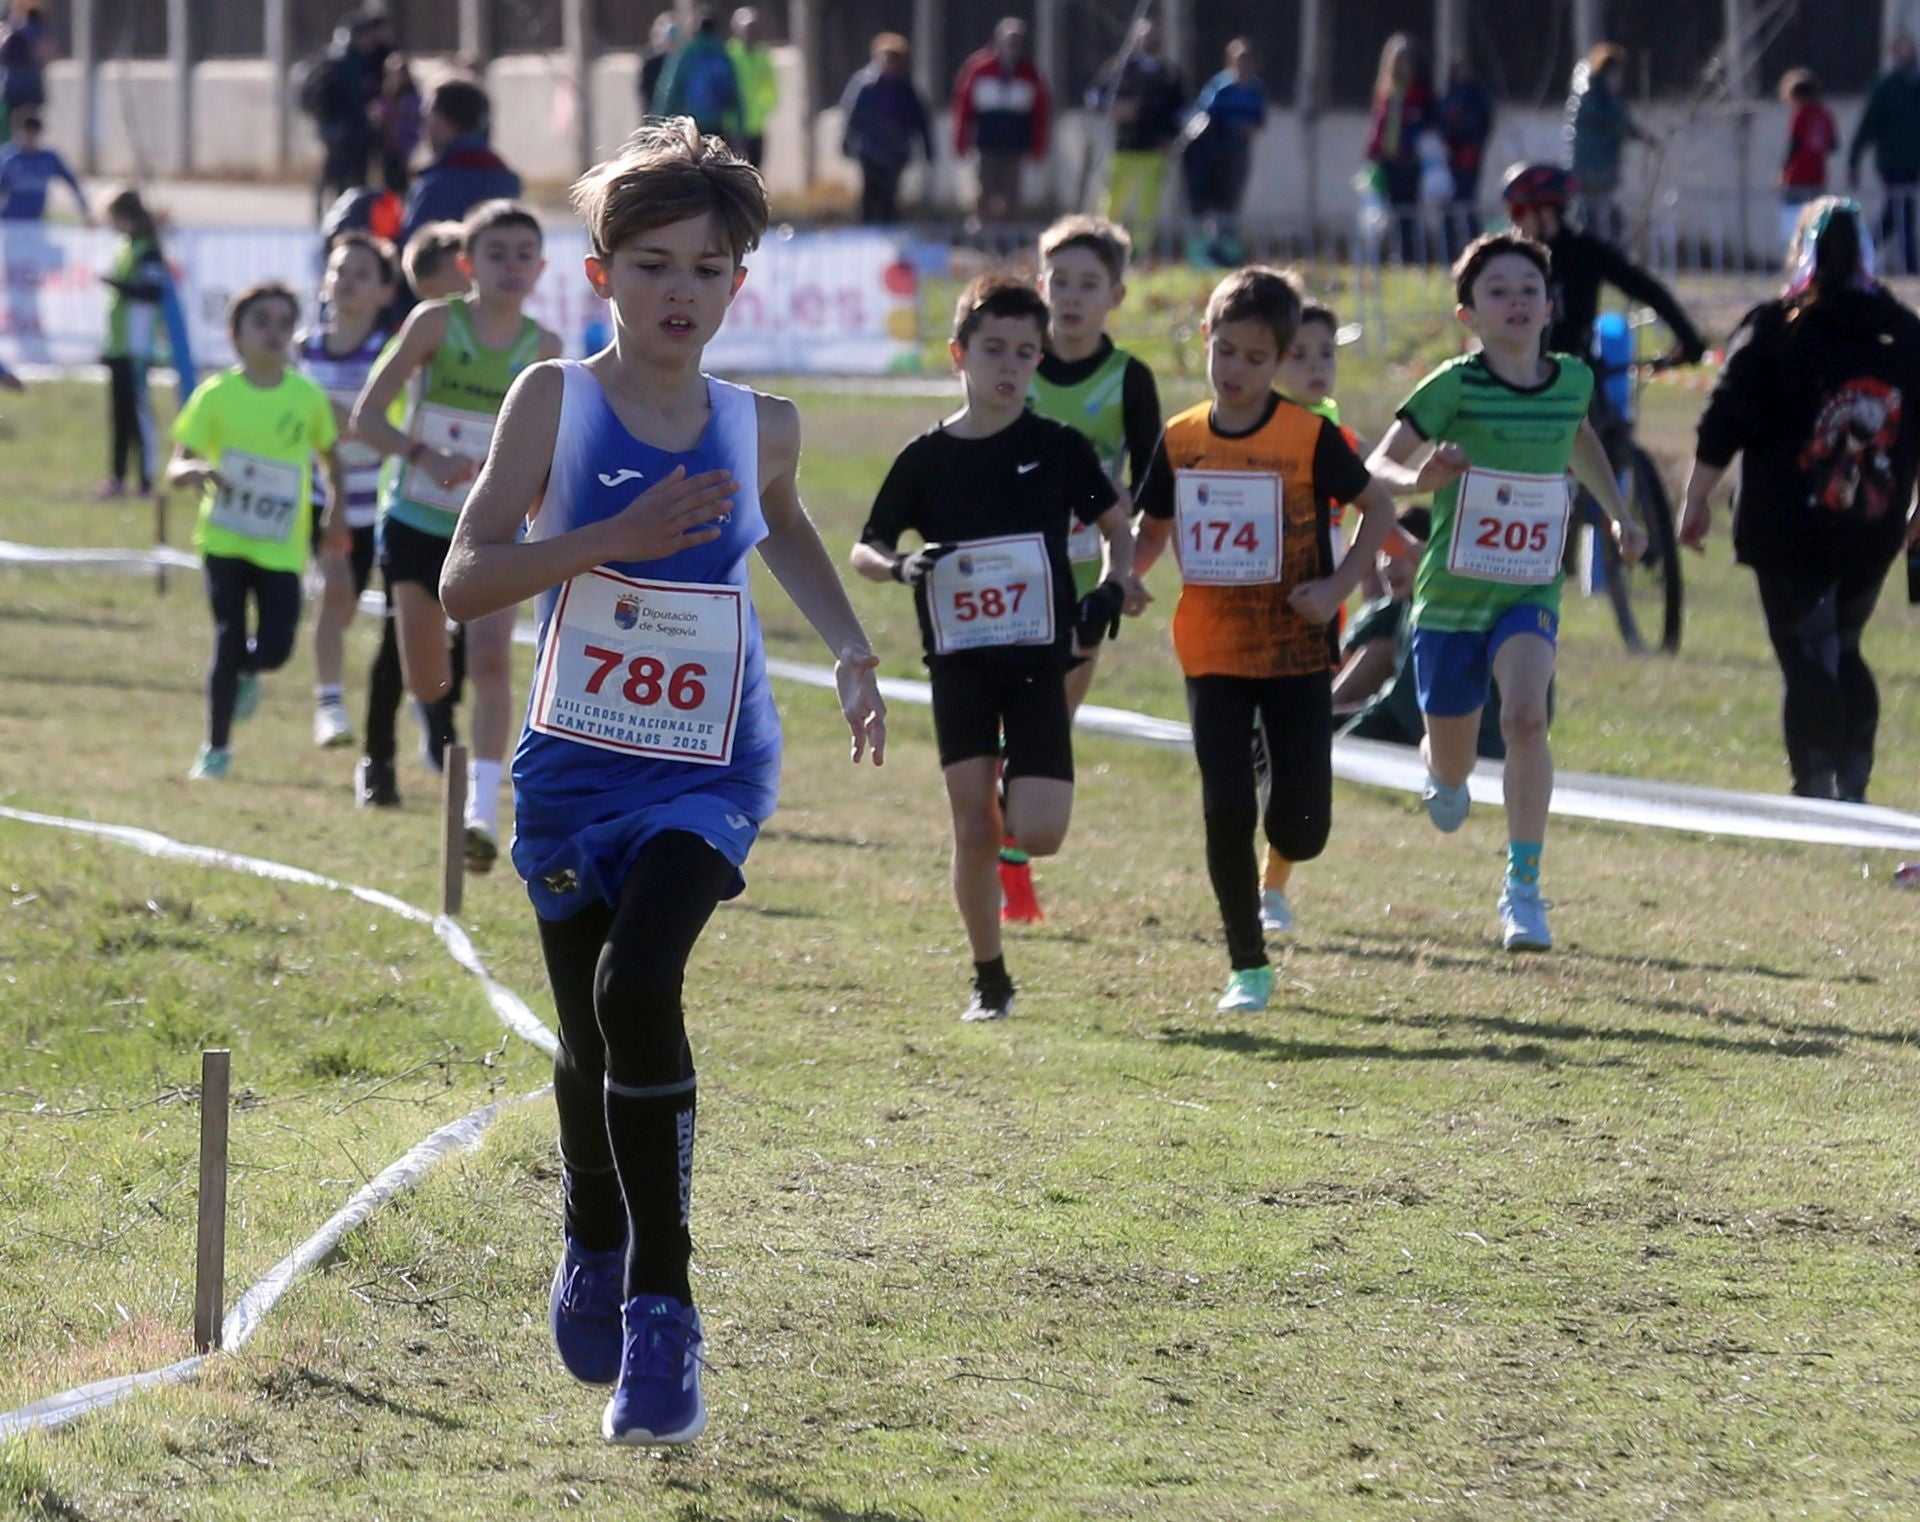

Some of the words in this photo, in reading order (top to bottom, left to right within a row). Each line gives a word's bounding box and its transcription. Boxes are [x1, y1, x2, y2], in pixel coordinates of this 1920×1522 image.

[217, 482, 294, 524] 1107
[1191, 521, 1259, 553] 174
[1475, 517, 1549, 553] 205
[642, 607, 698, 622] Diputación
[953, 582, 1028, 623] 587
[639, 622, 653, 632] de
[656, 623, 697, 637] Segovia
[584, 645, 708, 711] 786
[556, 698, 580, 714] LIII
[584, 705, 625, 723] CROSS
[629, 712, 693, 733] NACIONAL
[698, 723, 714, 735] DE
[556, 713, 661, 746] CANTIMPALOS
[672, 736, 708, 751] 2025
